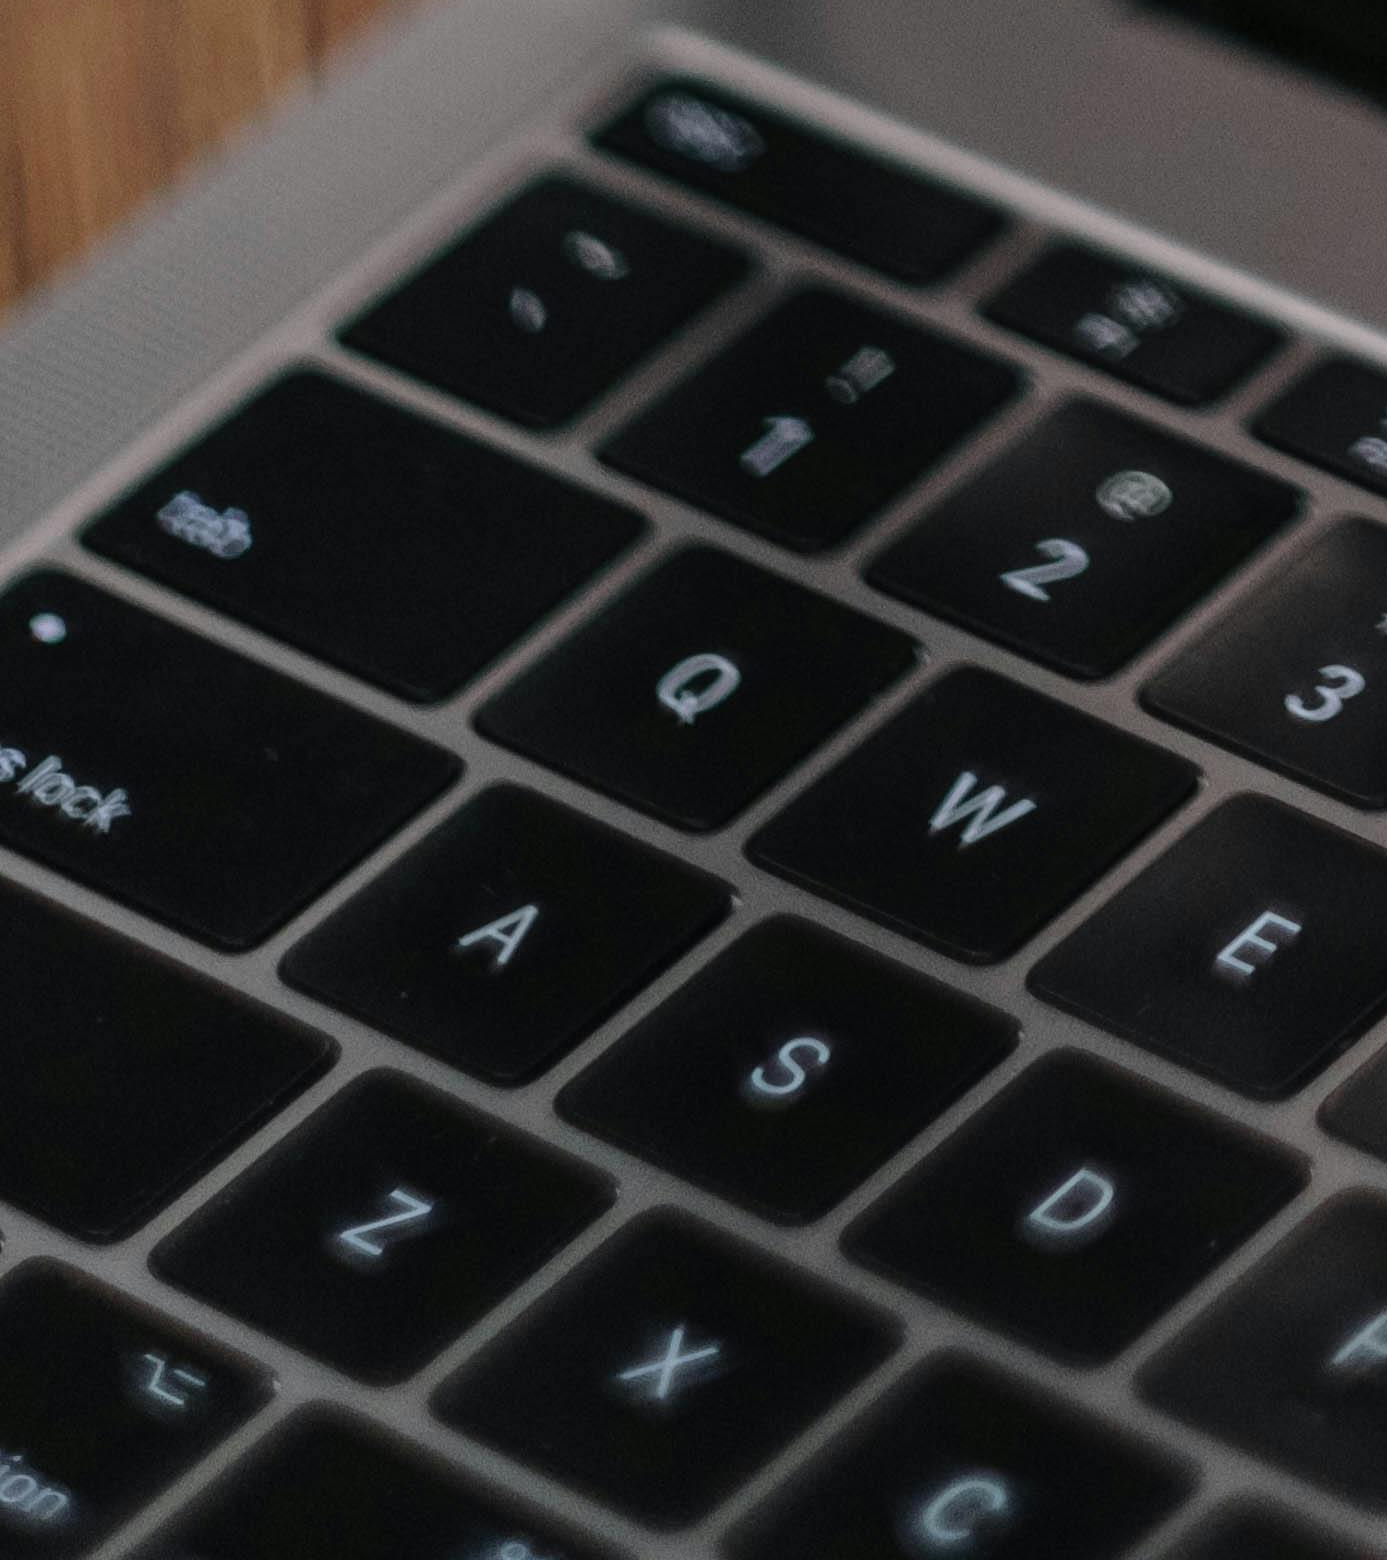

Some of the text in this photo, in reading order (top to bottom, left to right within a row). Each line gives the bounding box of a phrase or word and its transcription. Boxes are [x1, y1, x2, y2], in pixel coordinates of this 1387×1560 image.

[1000, 537, 1090, 602] 2
[656, 652, 742, 724] Q
[1284, 662, 1367, 723] 3
[928, 770, 1037, 847] W
[456, 903, 540, 967] A
[1214, 908, 1303, 977] E
[747, 1034, 833, 1099] S
[334, 1186, 434, 1258] Z
[1025, 1165, 1117, 1236] D
[616, 1324, 721, 1402] X
[911, 1471, 1011, 1549] C
